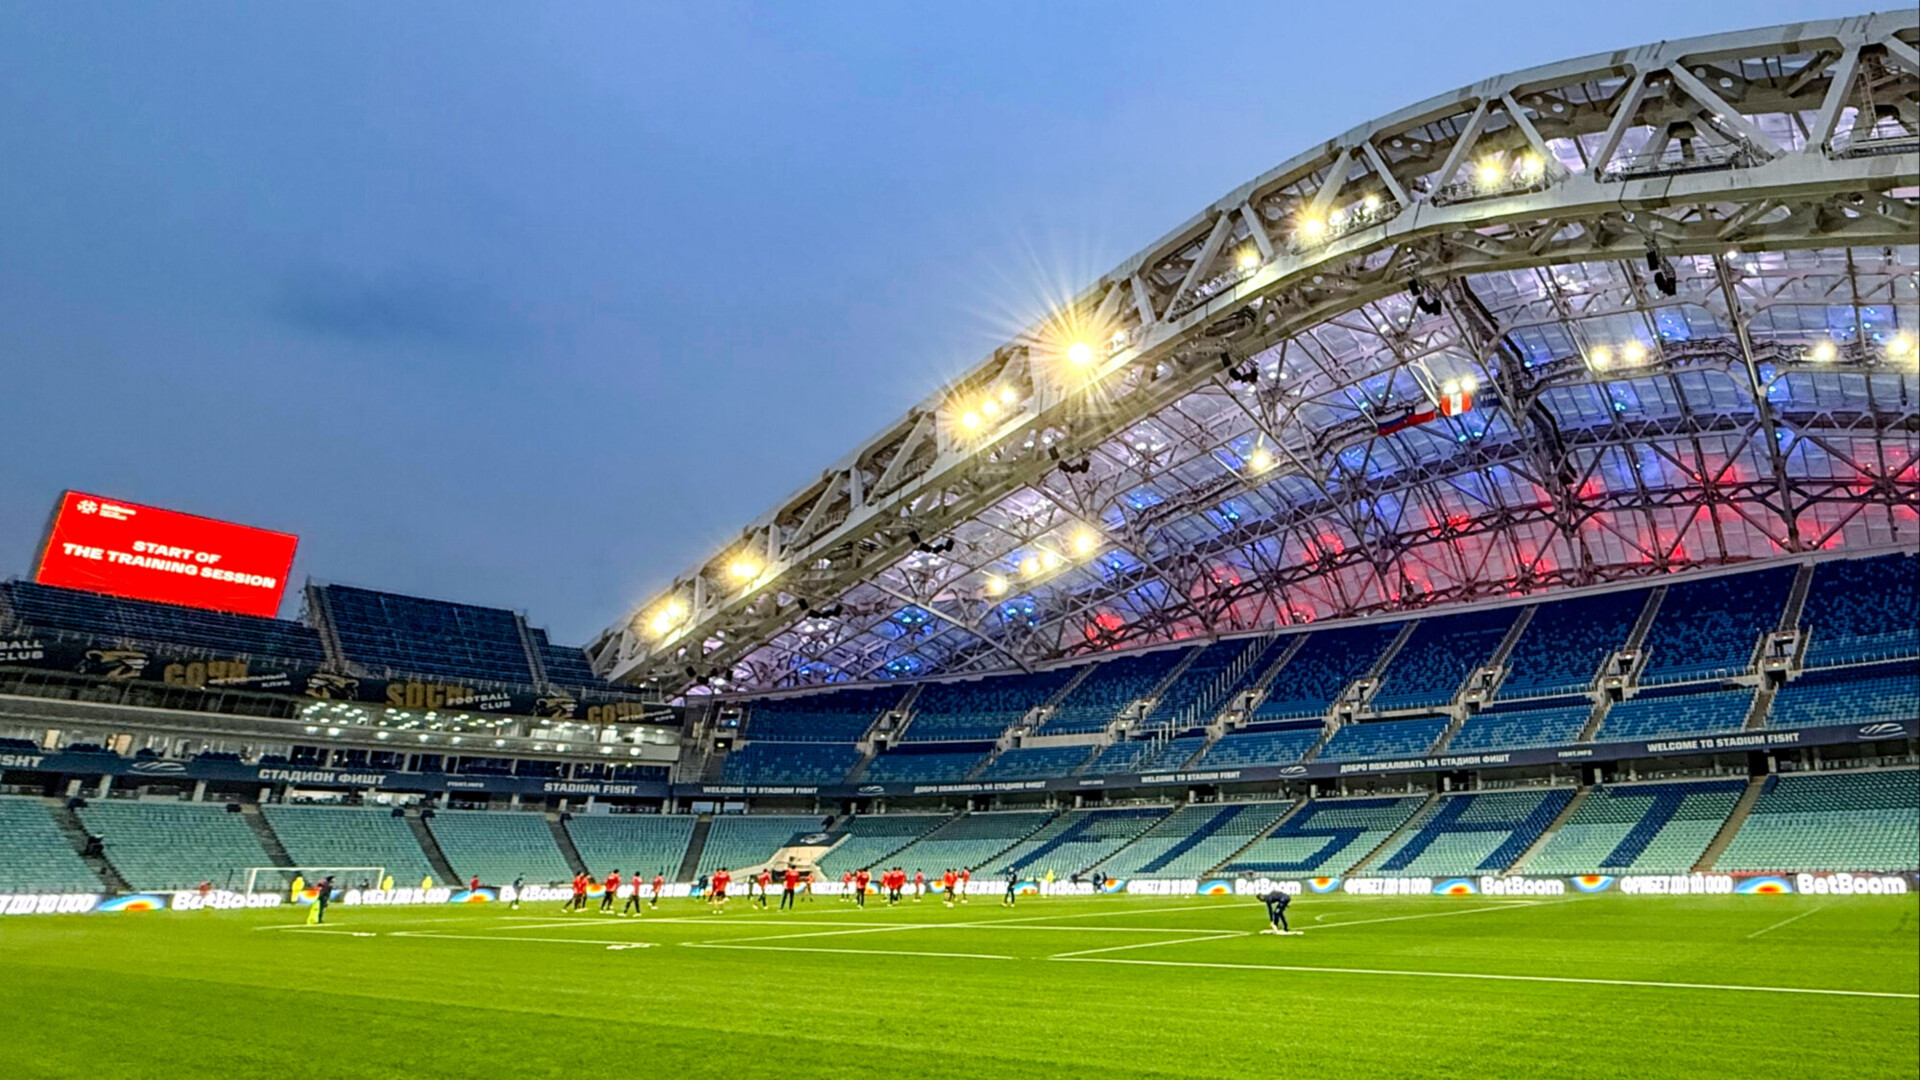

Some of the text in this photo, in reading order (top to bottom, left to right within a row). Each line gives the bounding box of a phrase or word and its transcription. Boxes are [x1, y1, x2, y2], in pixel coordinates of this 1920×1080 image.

[132, 540, 222, 565] START OF
[62, 542, 276, 589] THE TRAINING SESSION
[385, 682, 474, 709] SOCHI
[445, 692, 511, 706] FOOTBALL
[480, 701, 511, 710] CLUB
[1647, 733, 1800, 752] WELCOME TO STADIUM FISHT
[0, 754, 44, 767] SHT
[1340, 754, 1510, 773] ДОБРО ПОЖАЛОВАТЬ НА СТАДИОН ФИШТ
[258, 769, 386, 785] СТАДИОН ФИШТ
[1141, 771, 1241, 783] WELCOME TO STADIUM FISHT
[544, 782, 638, 794] STADIUM FISHT
[703, 786, 818, 795] WELCOME TO STADIUM FISHT
[1002, 778, 1748, 874] FISHT
[1235, 878, 1301, 895] BetBoom
[1480, 876, 1565, 895] BetBoom
[1796, 873, 1907, 894] BetBoom
